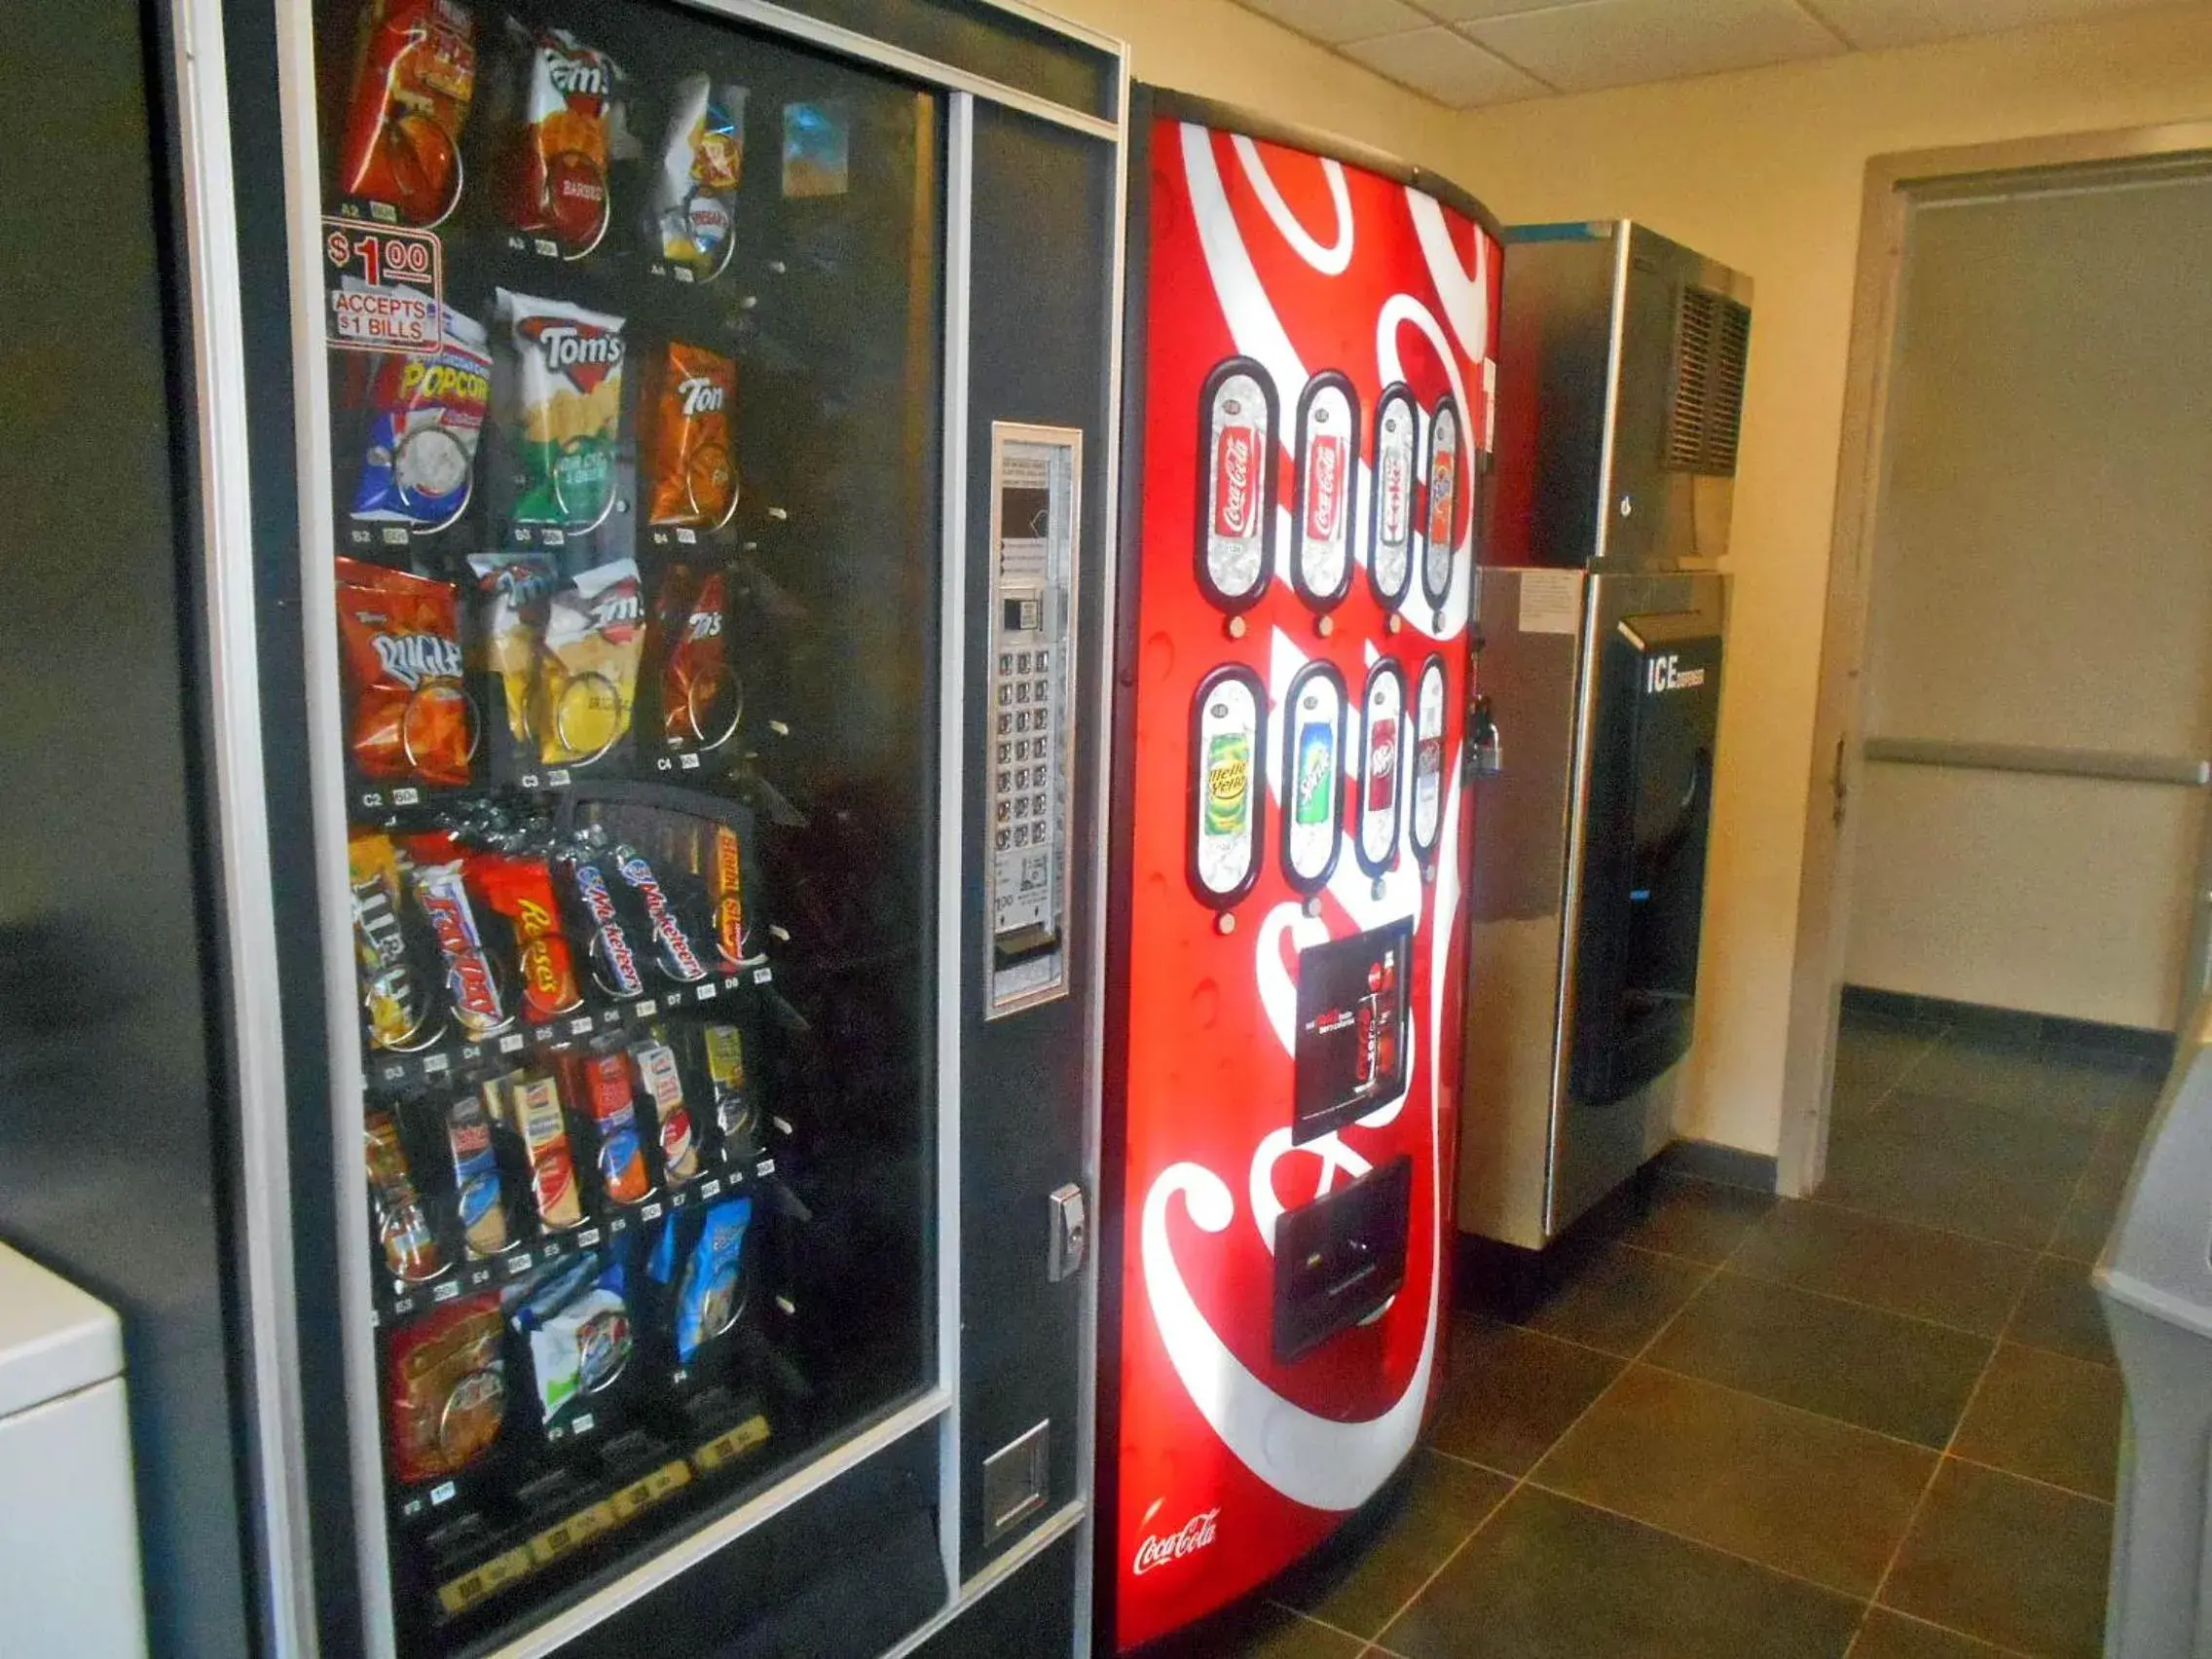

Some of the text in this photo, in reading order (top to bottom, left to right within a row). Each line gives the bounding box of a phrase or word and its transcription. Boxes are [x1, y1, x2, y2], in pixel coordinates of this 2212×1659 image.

[336, 293, 425, 318] ACCEPTS
[340, 315, 423, 340] $1 BILLS
[540, 326, 622, 369] Tom's
[398, 361, 490, 401] POPCOR
[371, 635, 463, 691] BUGLE
[1647, 654, 1678, 694] ICE
[521, 774, 539, 789] C3
[656, 757, 672, 771] C4
[362, 793, 383, 807] C2
[517, 897, 558, 994] Reese's
[1133, 1507, 1221, 1575] Coca-Cola
